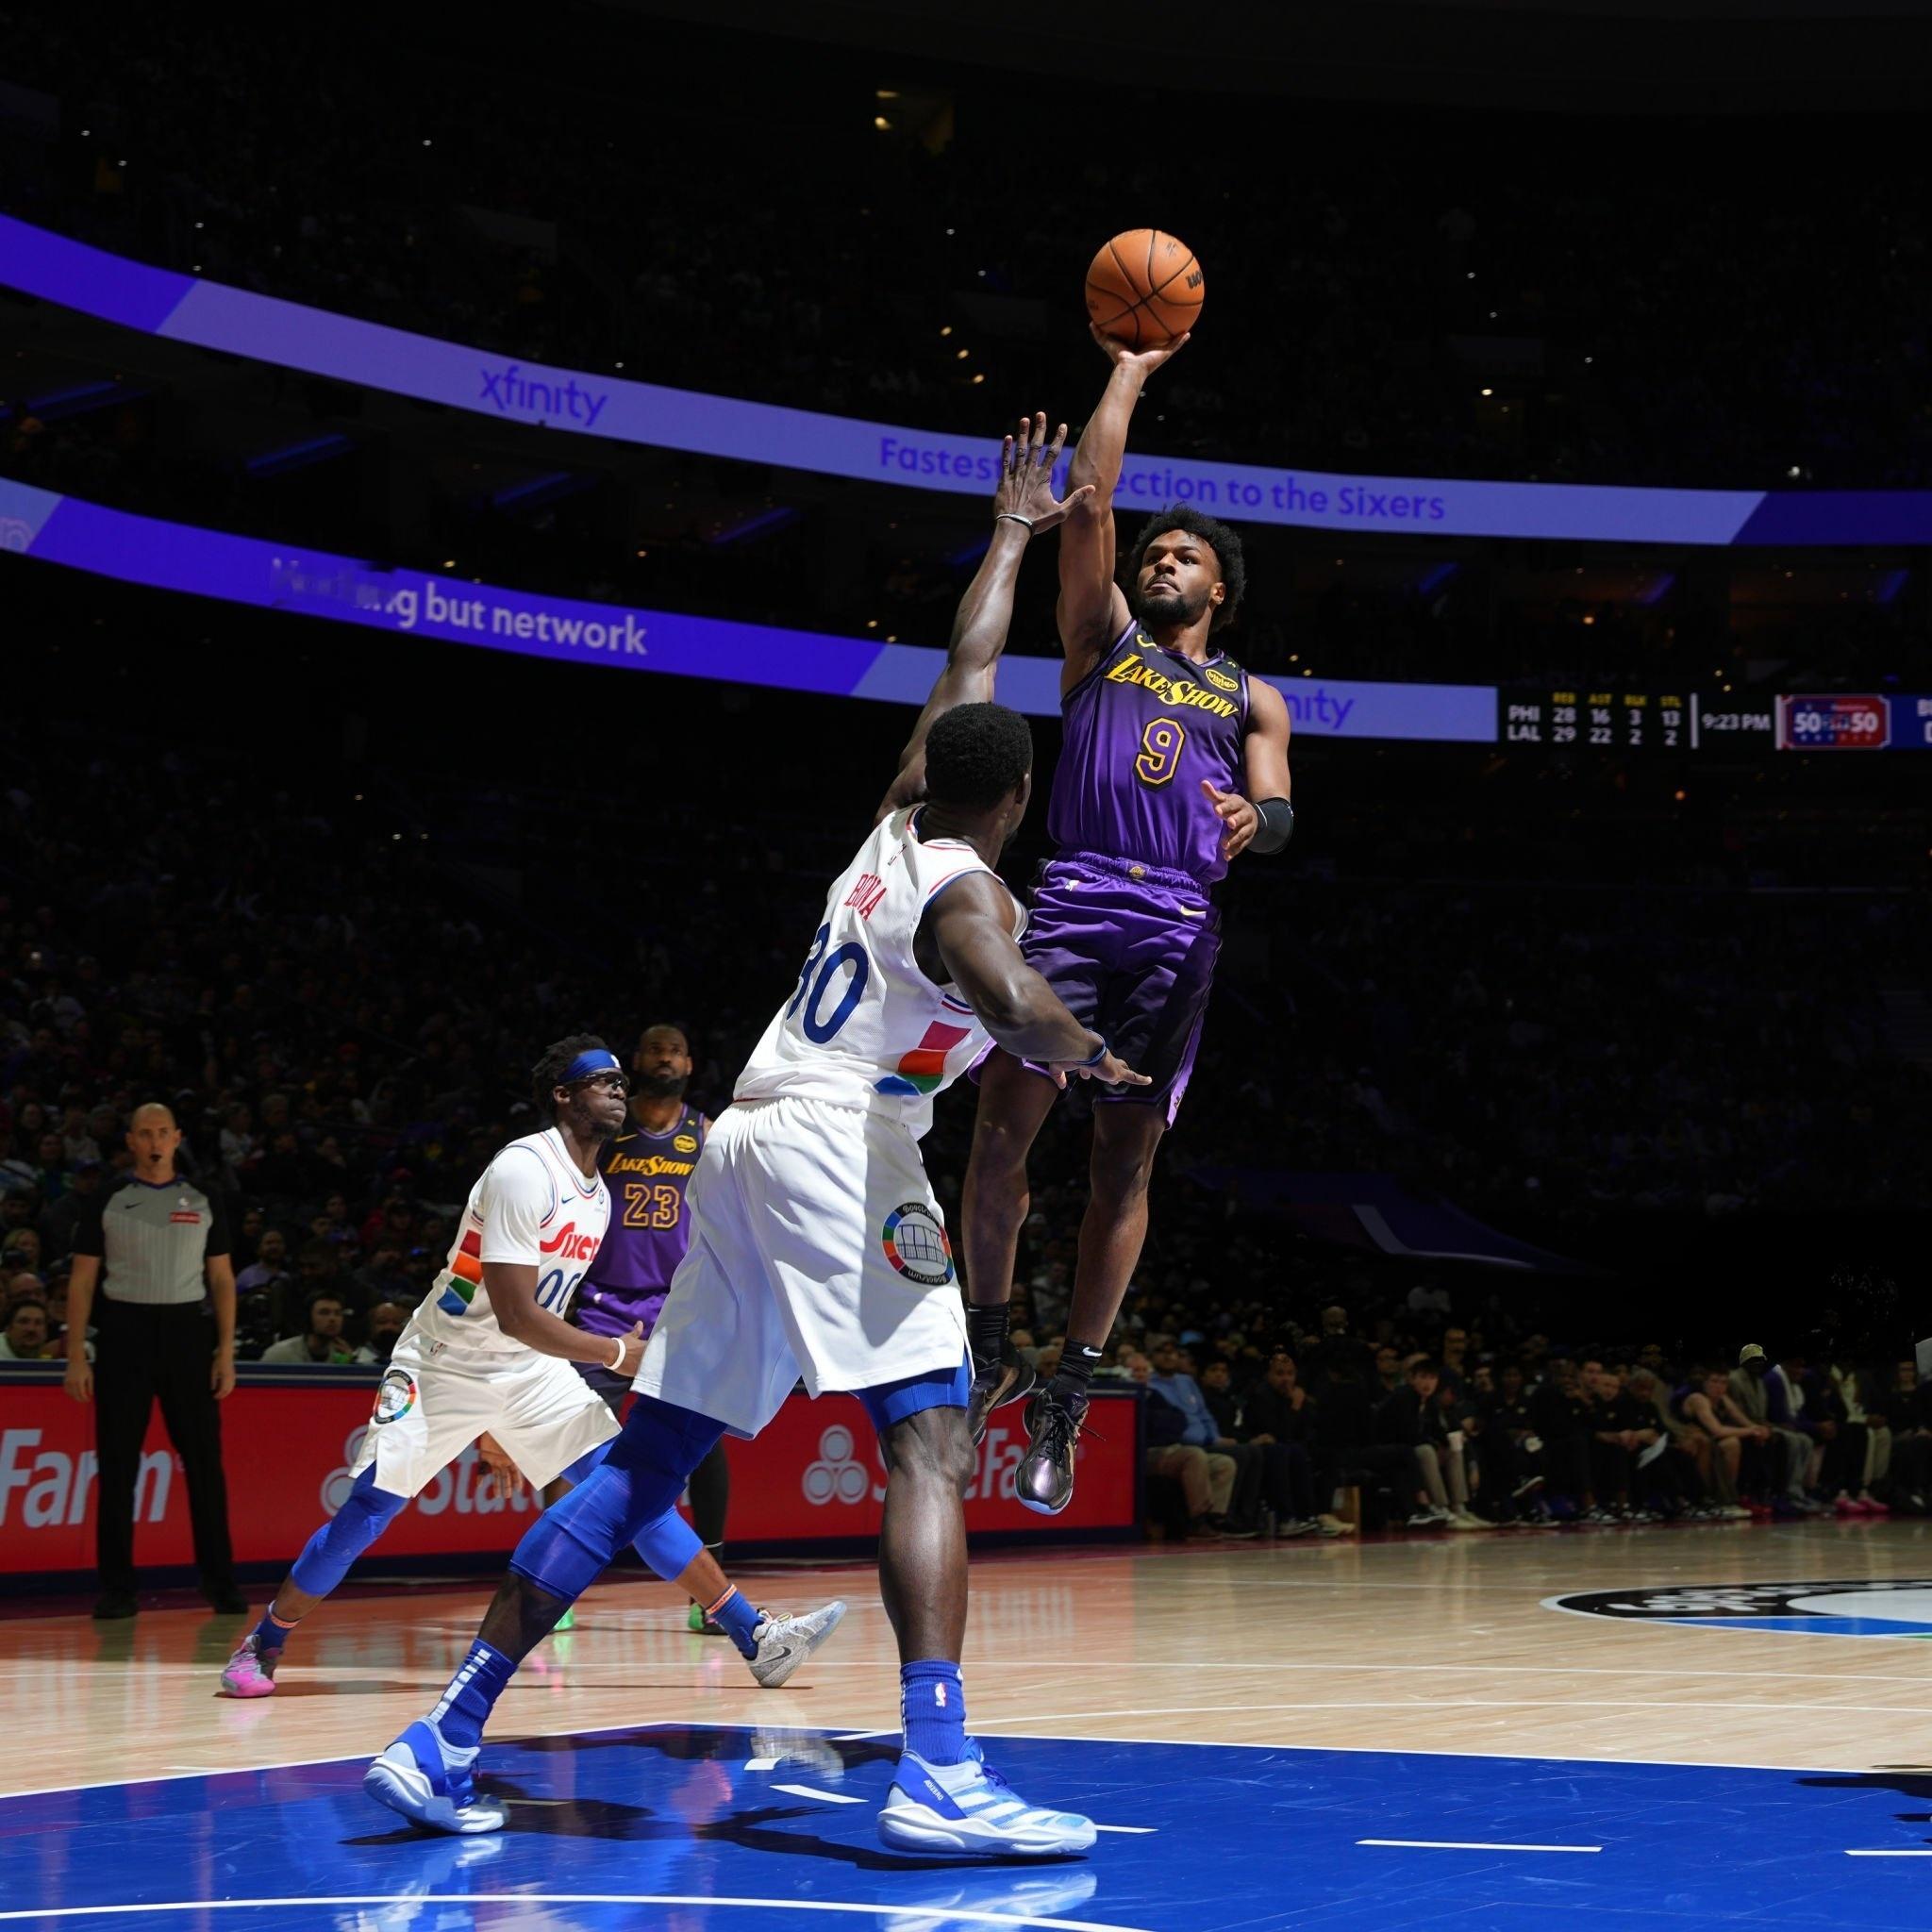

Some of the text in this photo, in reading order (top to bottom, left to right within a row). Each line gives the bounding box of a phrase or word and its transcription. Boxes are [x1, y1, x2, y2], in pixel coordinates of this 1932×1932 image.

[480, 366, 607, 425] xfinity
[1226, 480, 1262, 506] to
[1271, 476, 1328, 512] the
[1338, 486, 1445, 520] Sixers
[425, 580, 486, 630] but
[491, 606, 648, 656] network
[1508, 706, 1681, 727] PHI 28 16 3 13
[1508, 724, 1678, 746] LAL 29 22 2 2
[1702, 713, 1772, 731] 9:23 PM
[1793, 711, 1823, 734] 50
[1850, 711, 1880, 734] 50
[1136, 717, 1185, 785] 9
[623, 1183, 680, 1229] 23
